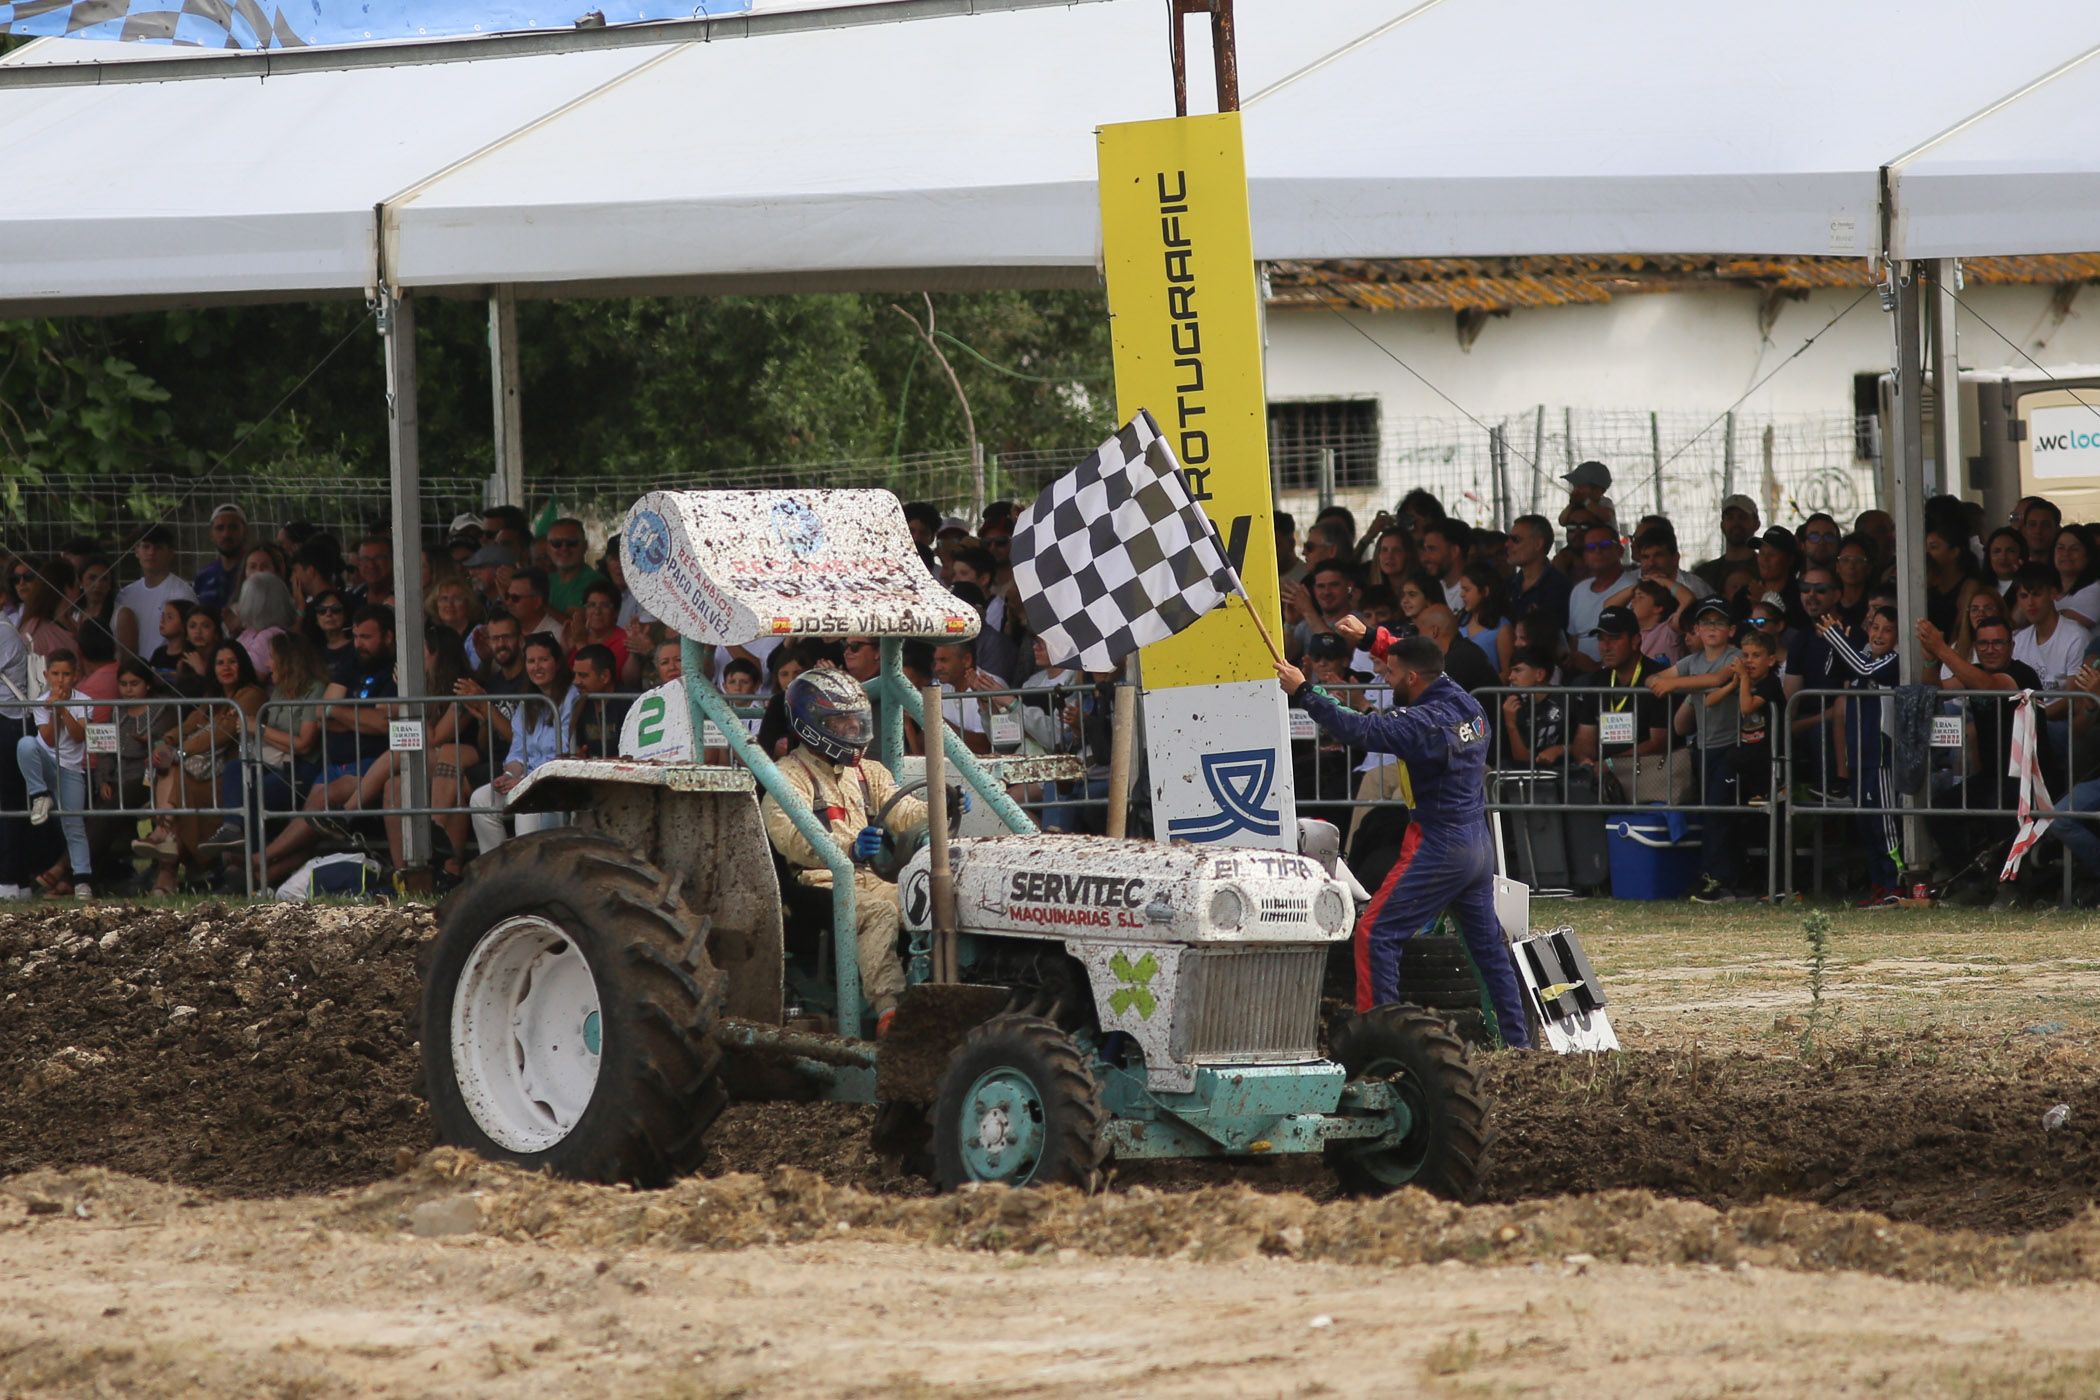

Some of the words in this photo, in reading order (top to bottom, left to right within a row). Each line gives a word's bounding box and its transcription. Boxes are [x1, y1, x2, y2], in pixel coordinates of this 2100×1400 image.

[667, 556, 692, 594] PACO
[677, 547, 734, 618] RECAMBIOS
[793, 616, 850, 633] JOSE
[638, 695, 666, 748] 2
[1257, 857, 1313, 880] TIRA
[1010, 871, 1145, 909] SERVITEC
[1009, 906, 1112, 927] MAQUINARIAS
[1117, 911, 1144, 929] S.L.
